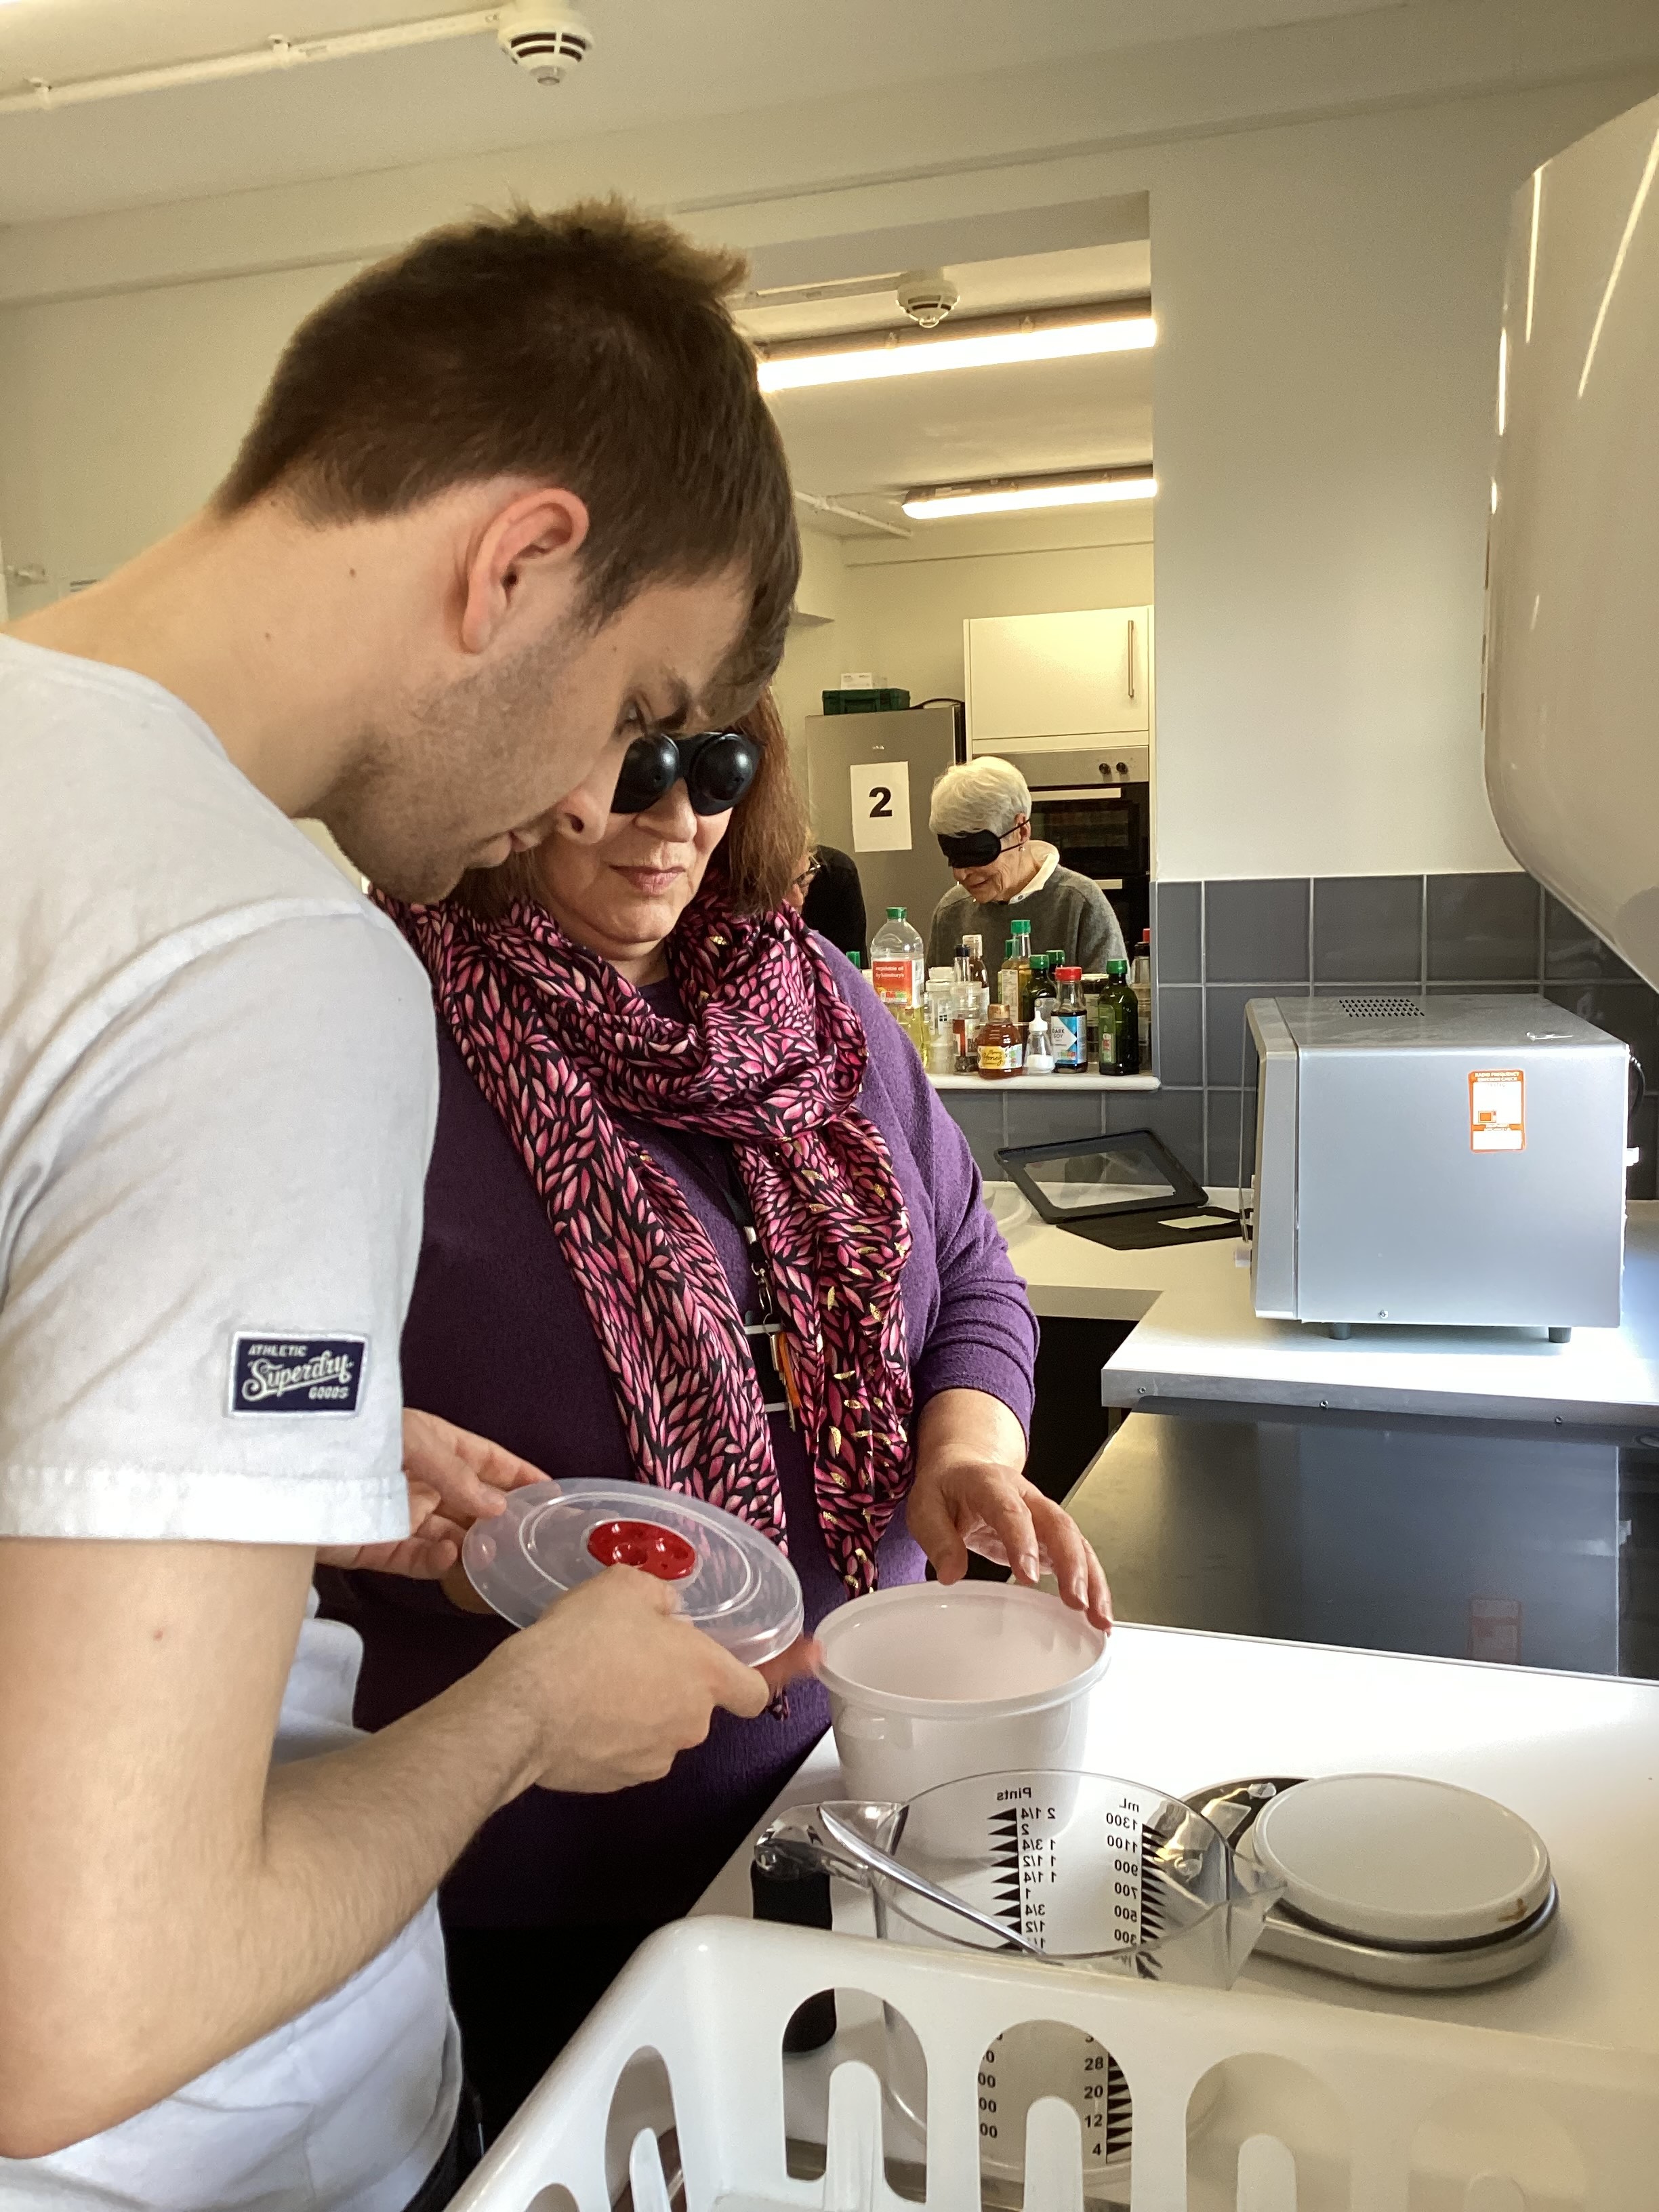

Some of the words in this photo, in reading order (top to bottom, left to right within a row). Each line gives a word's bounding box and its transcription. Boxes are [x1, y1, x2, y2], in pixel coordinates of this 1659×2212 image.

[869, 786, 893, 818] 2
[248, 1344, 308, 1357] ATHLETIC
[241, 1350, 354, 1402] Superdry
[308, 1387, 349, 1399] GOODS
[1085, 2056, 1103, 2070] 28
[978, 2072, 996, 2088] 00
[1084, 2085, 1103, 2099] 20
[979, 2097, 997, 2113] 00
[1085, 2114, 1103, 2128] 12
[980, 2123, 998, 2138] 00
[1092, 2143, 1101, 2156] 4
